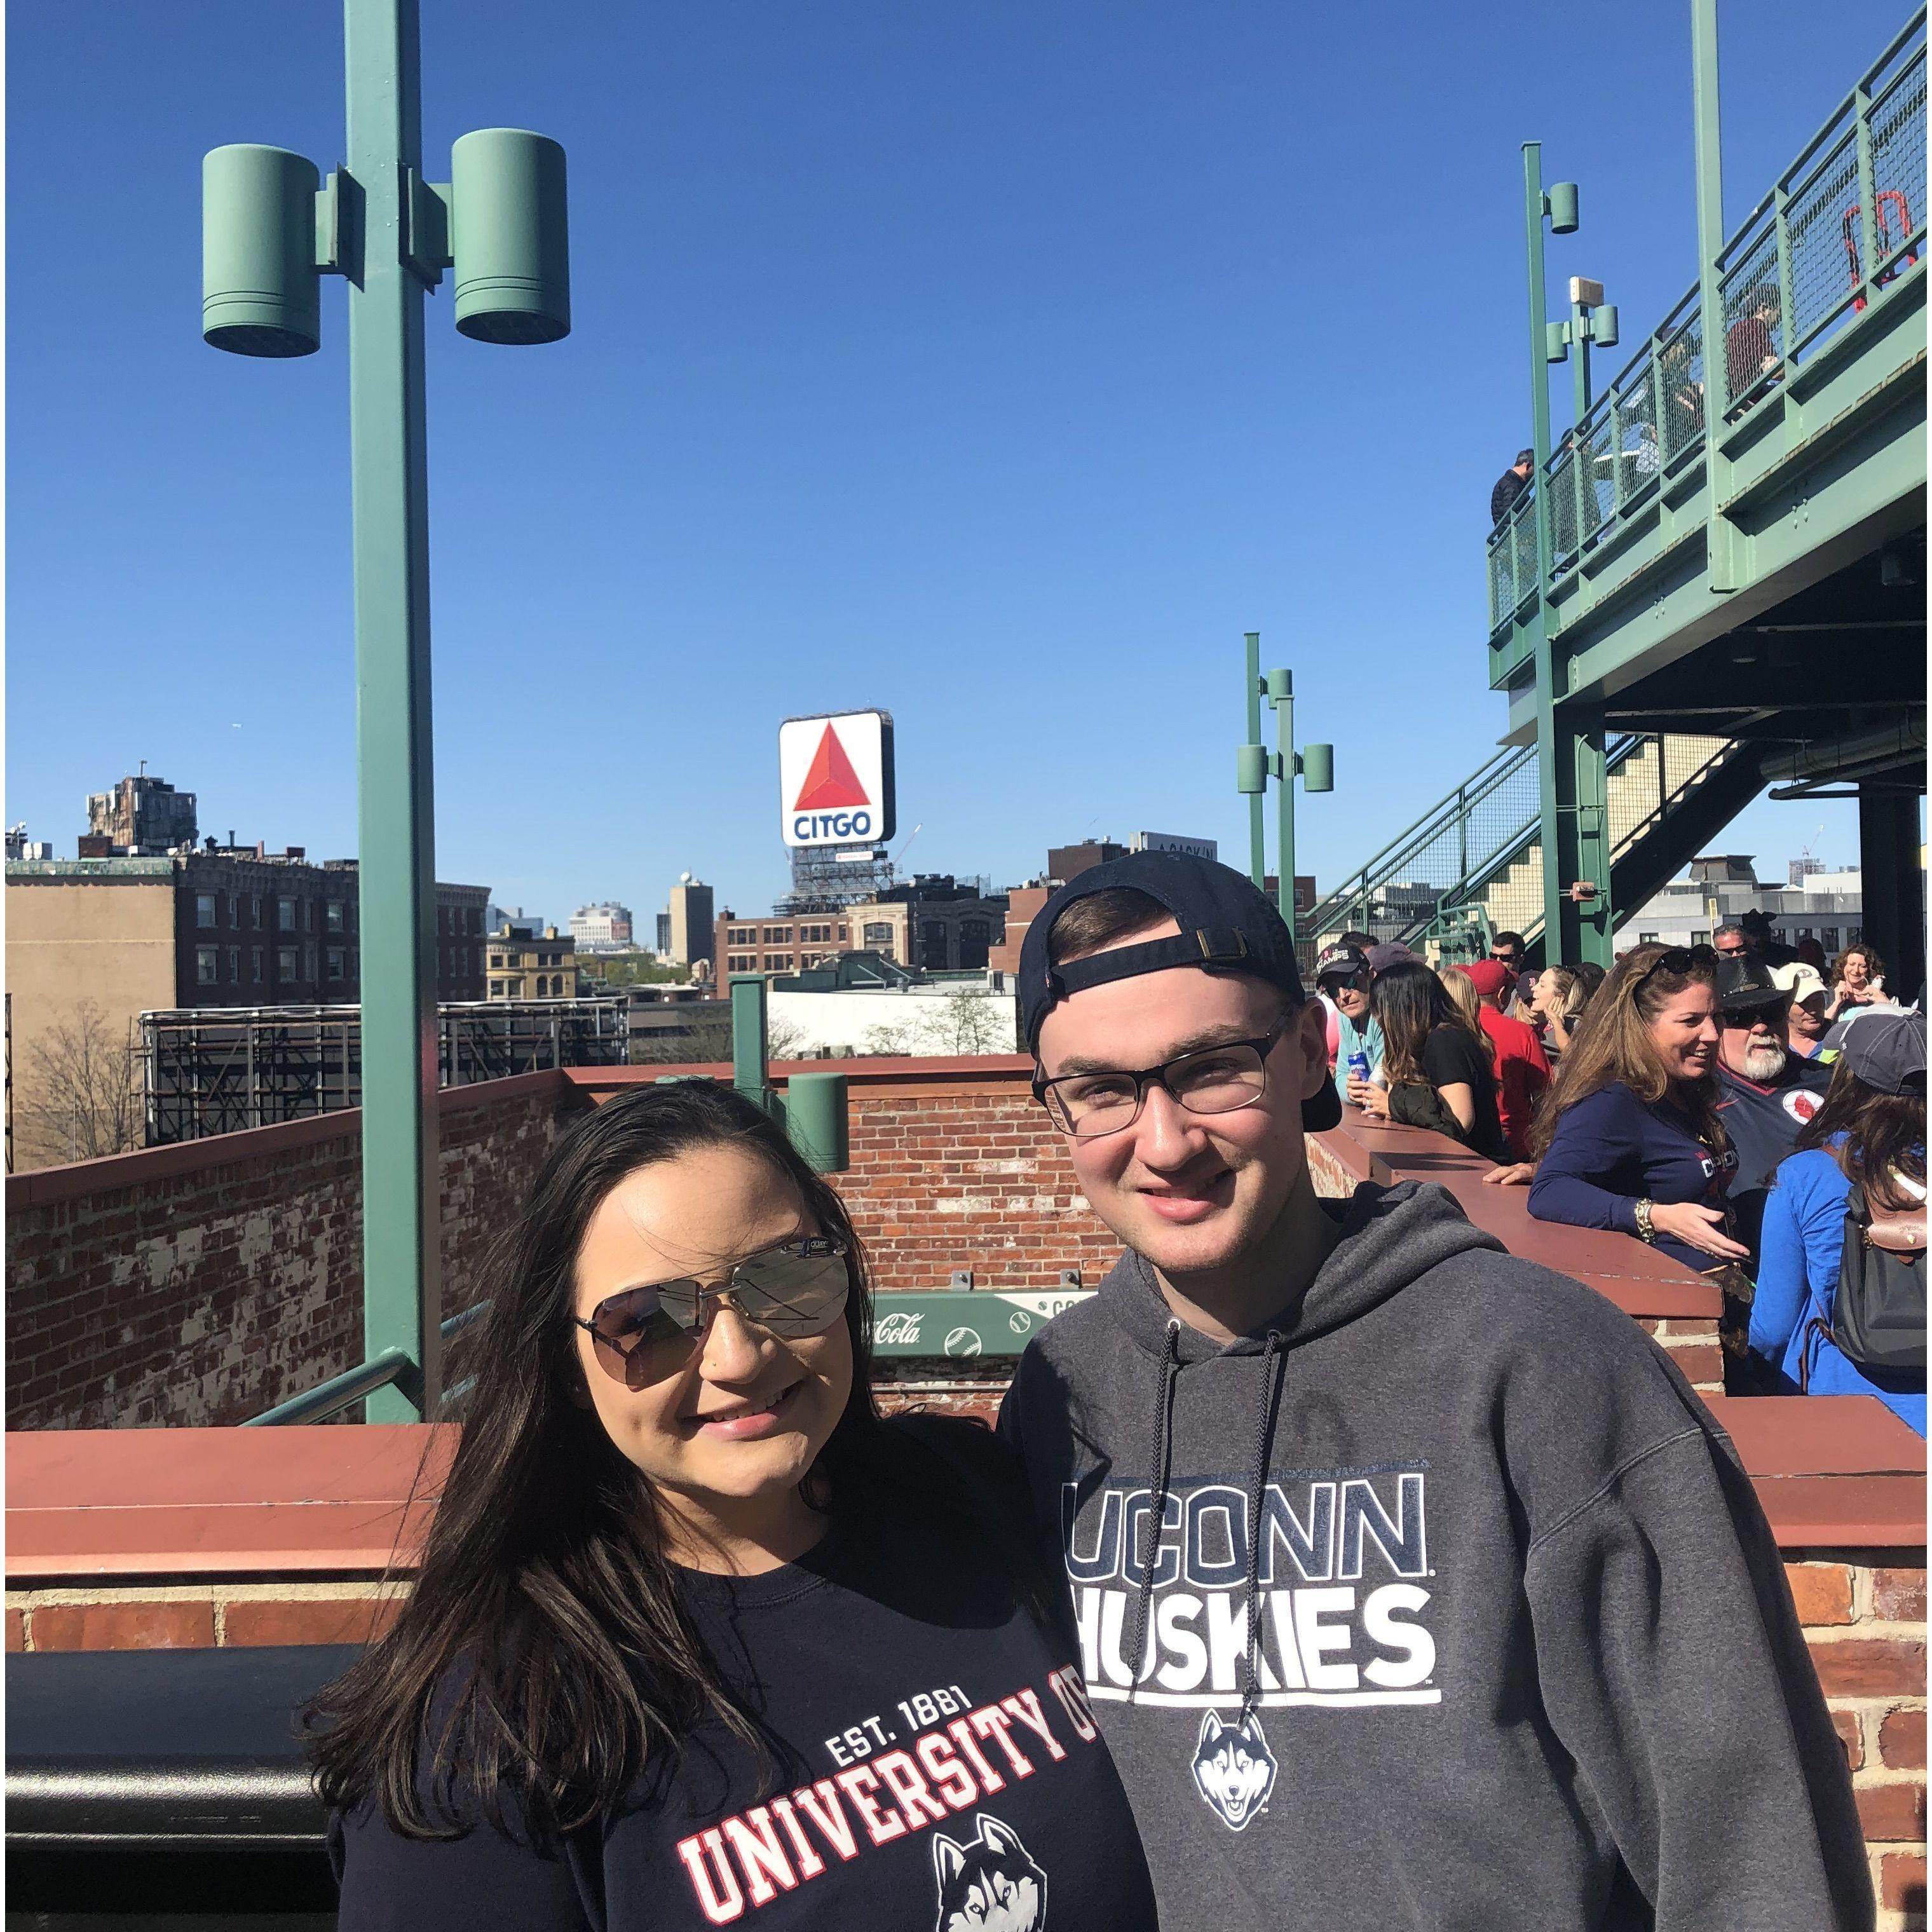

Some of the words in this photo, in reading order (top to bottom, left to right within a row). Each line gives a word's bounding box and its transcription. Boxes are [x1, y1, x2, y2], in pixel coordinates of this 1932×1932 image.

[794, 811, 871, 840] CITGO
[1061, 1473, 1428, 1589] UCONN
[1070, 1584, 1436, 1691] HUSKIES
[825, 1715, 897, 1768] EST.
[897, 1684, 973, 1732] 1881
[677, 1687, 1067, 1927] UNIVERSITY
